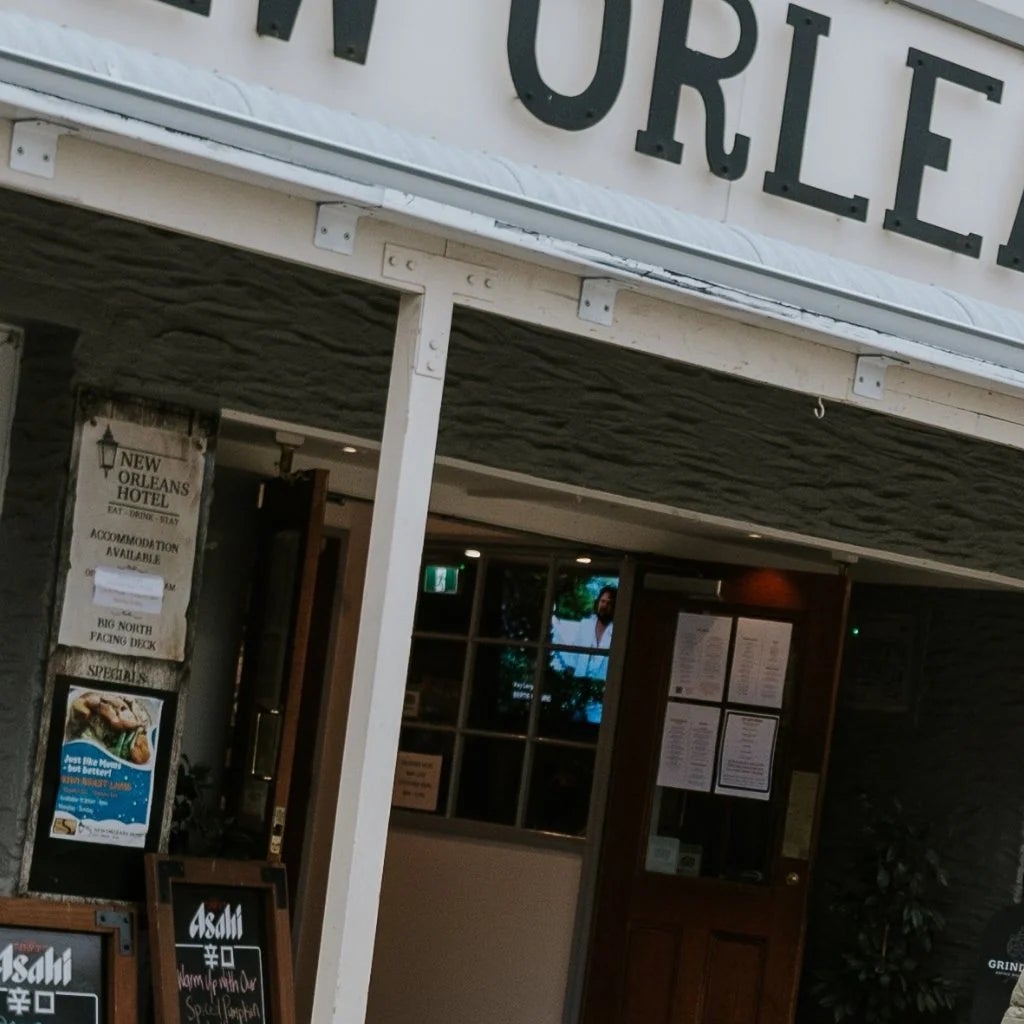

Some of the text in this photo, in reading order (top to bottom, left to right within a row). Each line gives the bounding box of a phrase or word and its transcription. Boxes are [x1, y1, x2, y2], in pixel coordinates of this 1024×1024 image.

[120, 451, 162, 473] NEW
[118, 470, 190, 496] ORLEANS
[117, 486, 170, 508] HOTEL
[107, 505, 122, 515] EAT
[90, 528, 179, 554] ACCOMMODATION
[106, 546, 161, 565] AVAILABLE
[98, 617, 153, 635] BIG NORTH
[90, 631, 157, 651] FACING DECK
[88, 664, 147, 683] SPECIALS
[189, 901, 243, 941] Asahi
[0, 943, 72, 987] Asahi
[203, 943, 235, 969] 辛口
[7, 987, 55, 1015] 辛口
